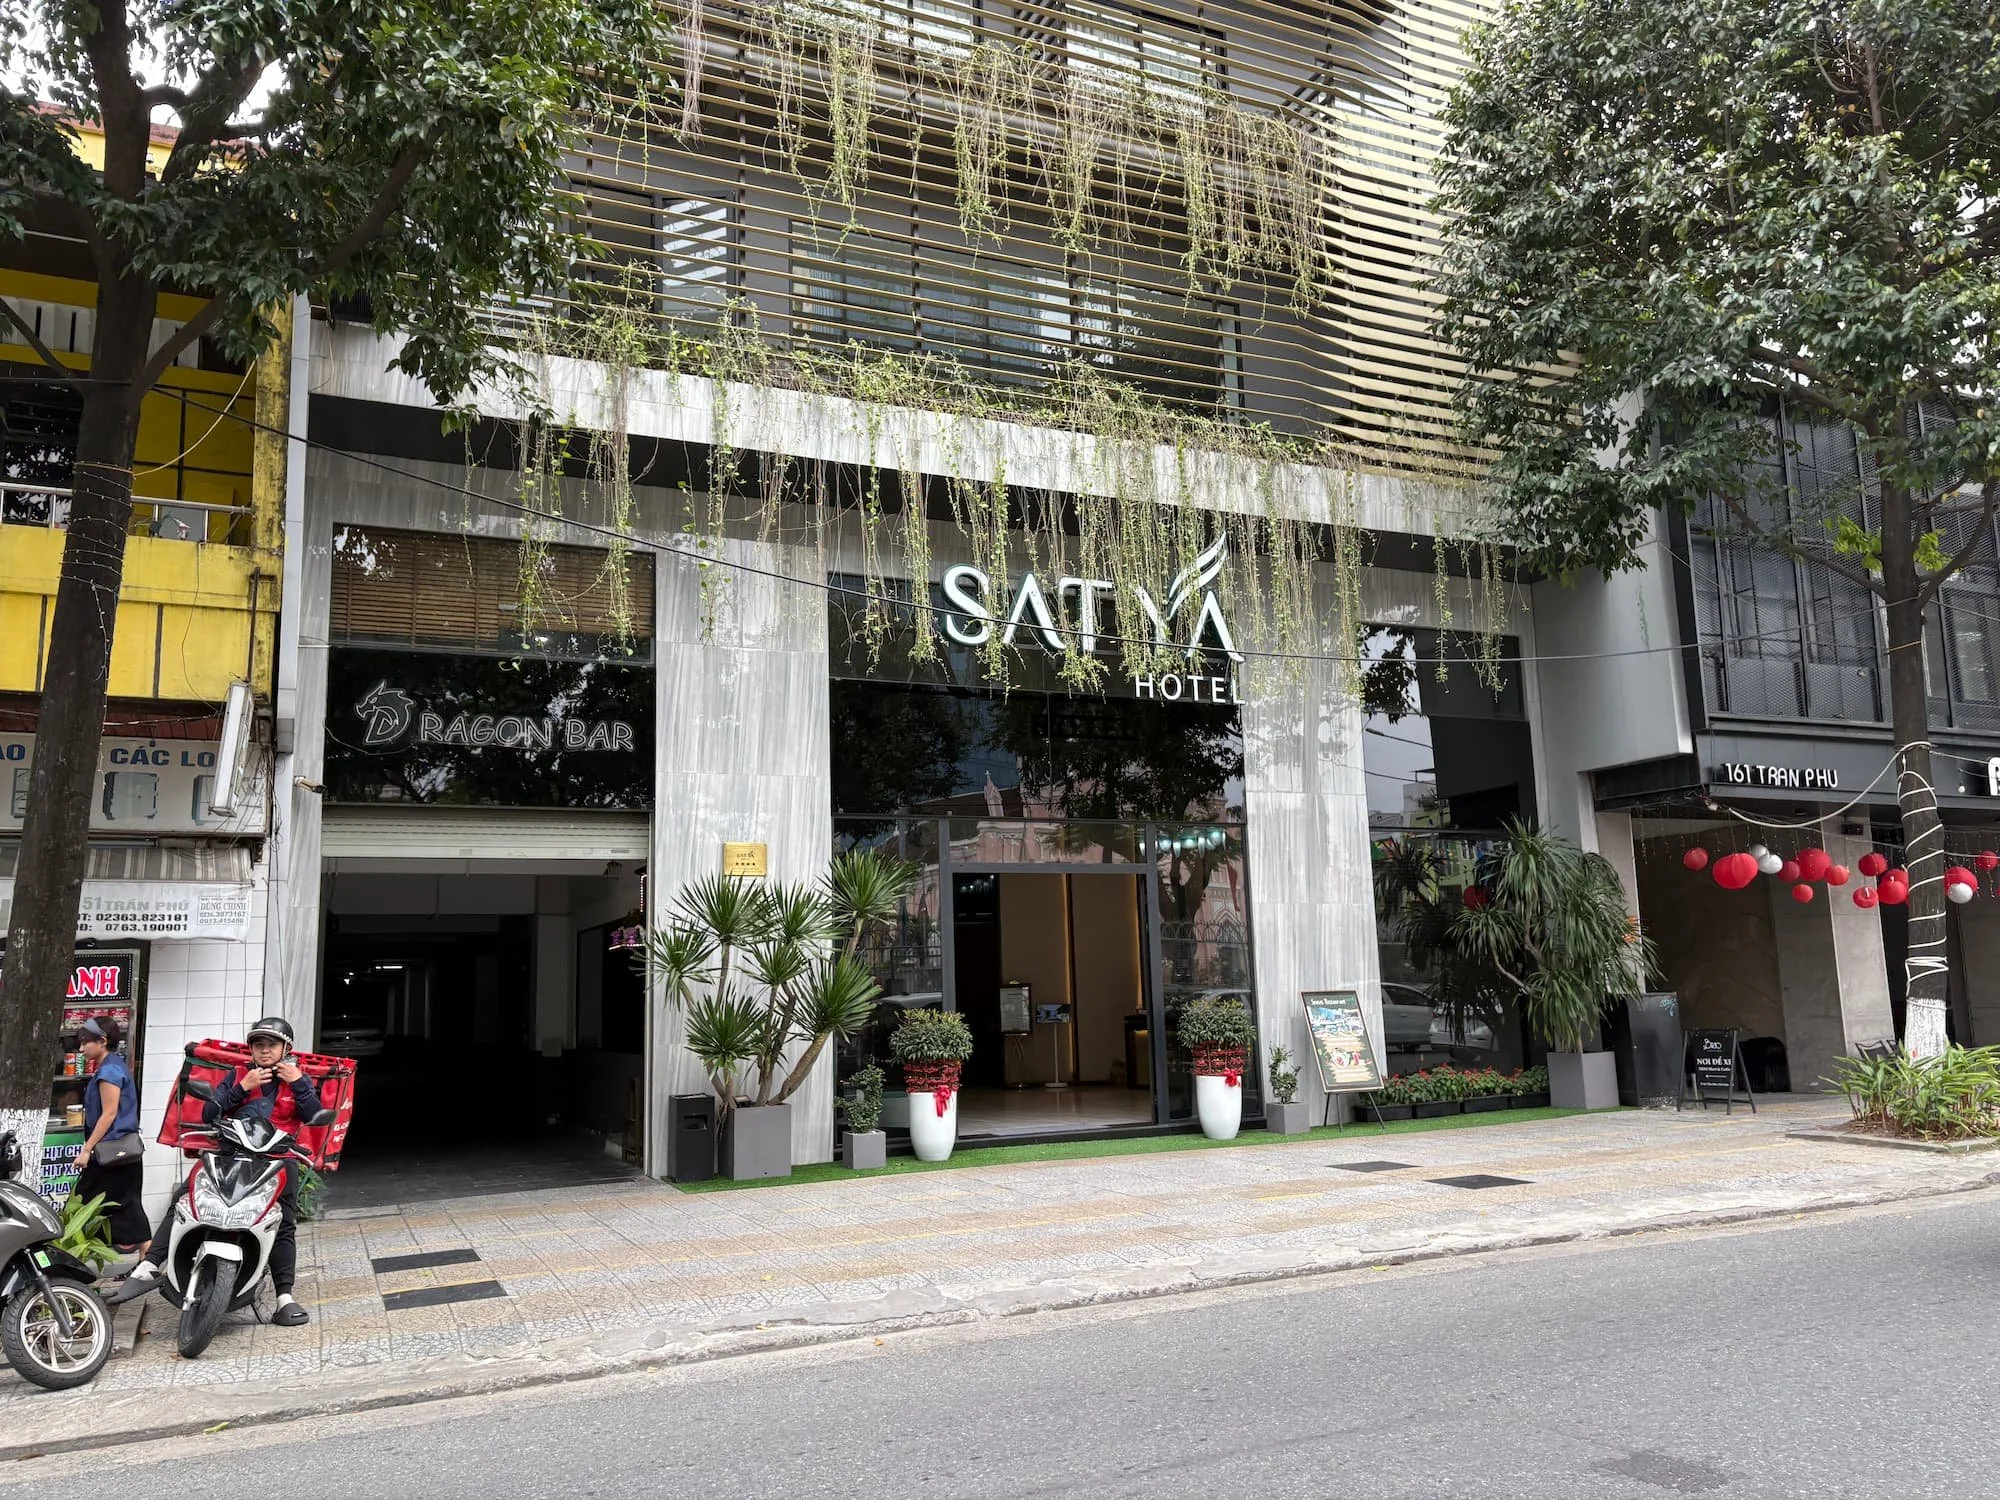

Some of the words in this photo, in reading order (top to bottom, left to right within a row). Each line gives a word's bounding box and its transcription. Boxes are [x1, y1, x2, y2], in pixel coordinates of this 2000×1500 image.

[942, 531, 1246, 662] SATYA
[1135, 673, 1246, 706] HOTEL
[566, 719, 635, 751] BAR
[110, 745, 170, 766] CÁC
[1725, 762, 1752, 784] 161
[1756, 764, 1800, 788] TRAN
[1804, 767, 1839, 789] PHU
